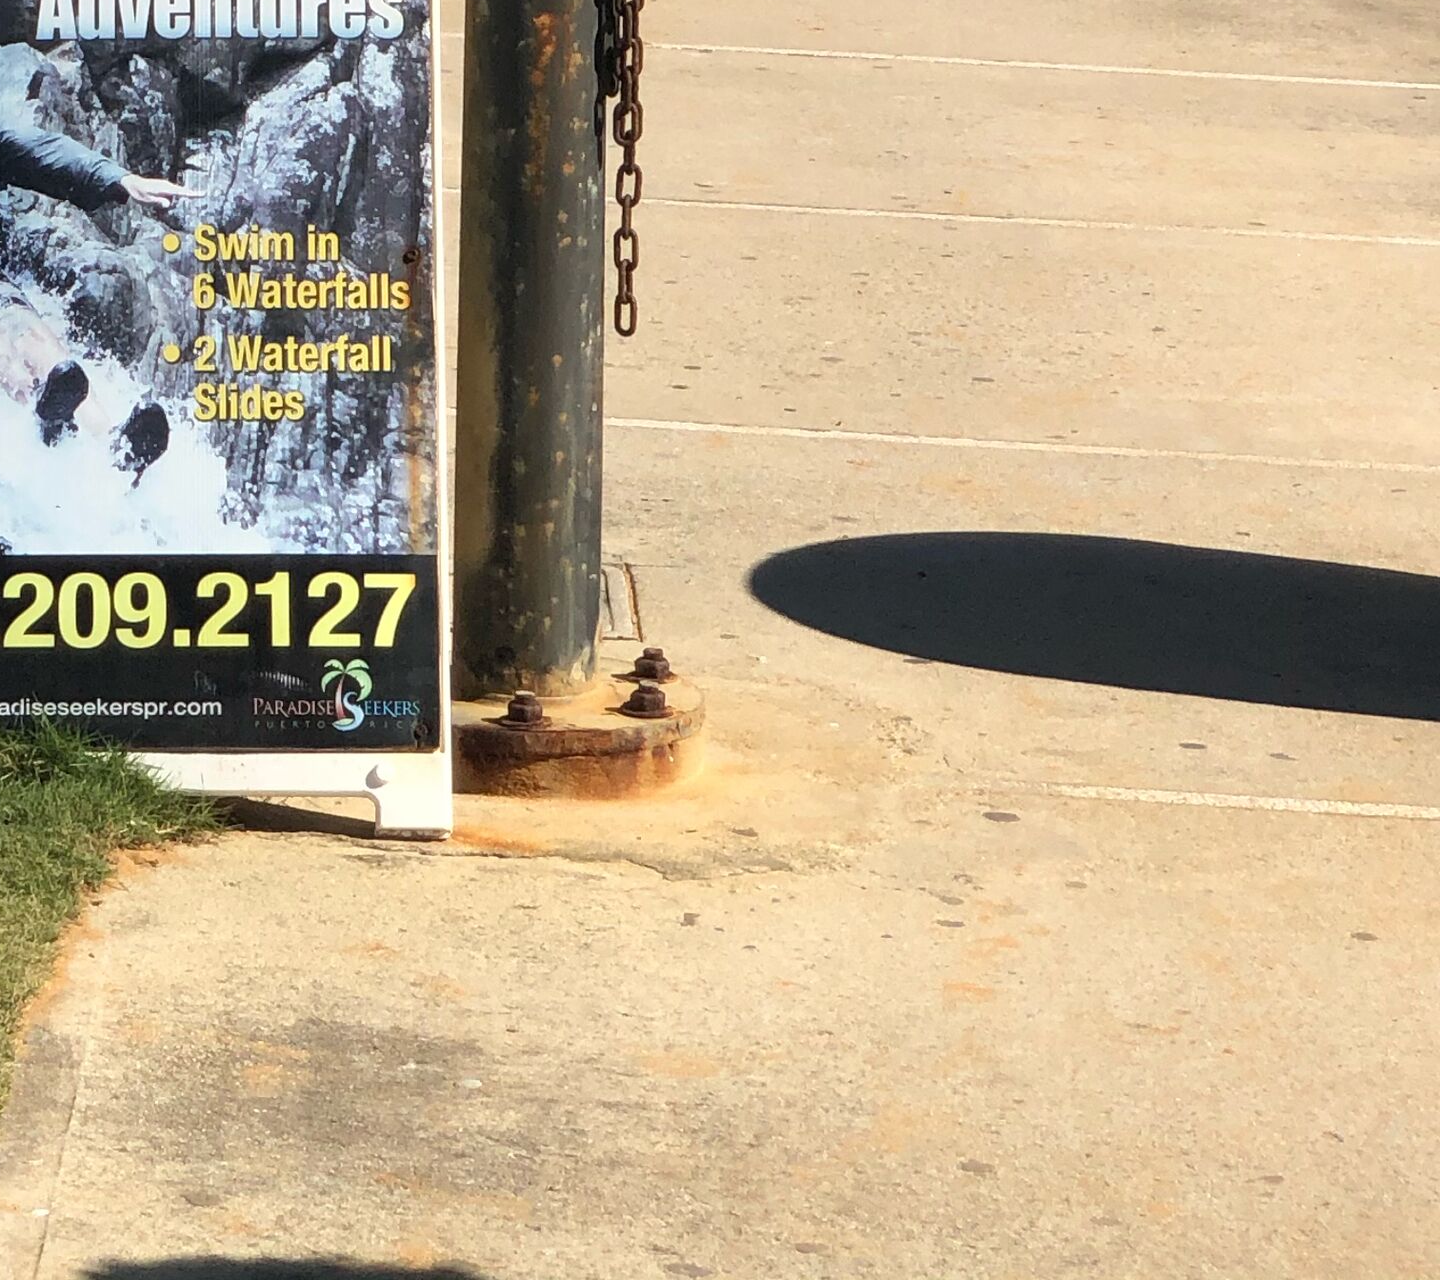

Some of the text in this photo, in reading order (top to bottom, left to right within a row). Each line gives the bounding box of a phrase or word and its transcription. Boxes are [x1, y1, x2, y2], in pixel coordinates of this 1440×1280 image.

[193, 224, 340, 262] Swim in
[192, 272, 411, 310] 6 Waterfalls
[193, 334, 392, 373] 2 Waterfall
[193, 382, 305, 421] Slides
[252, 697, 335, 718] PARADISE
[254, 720, 418, 730] PUERTO RIC
